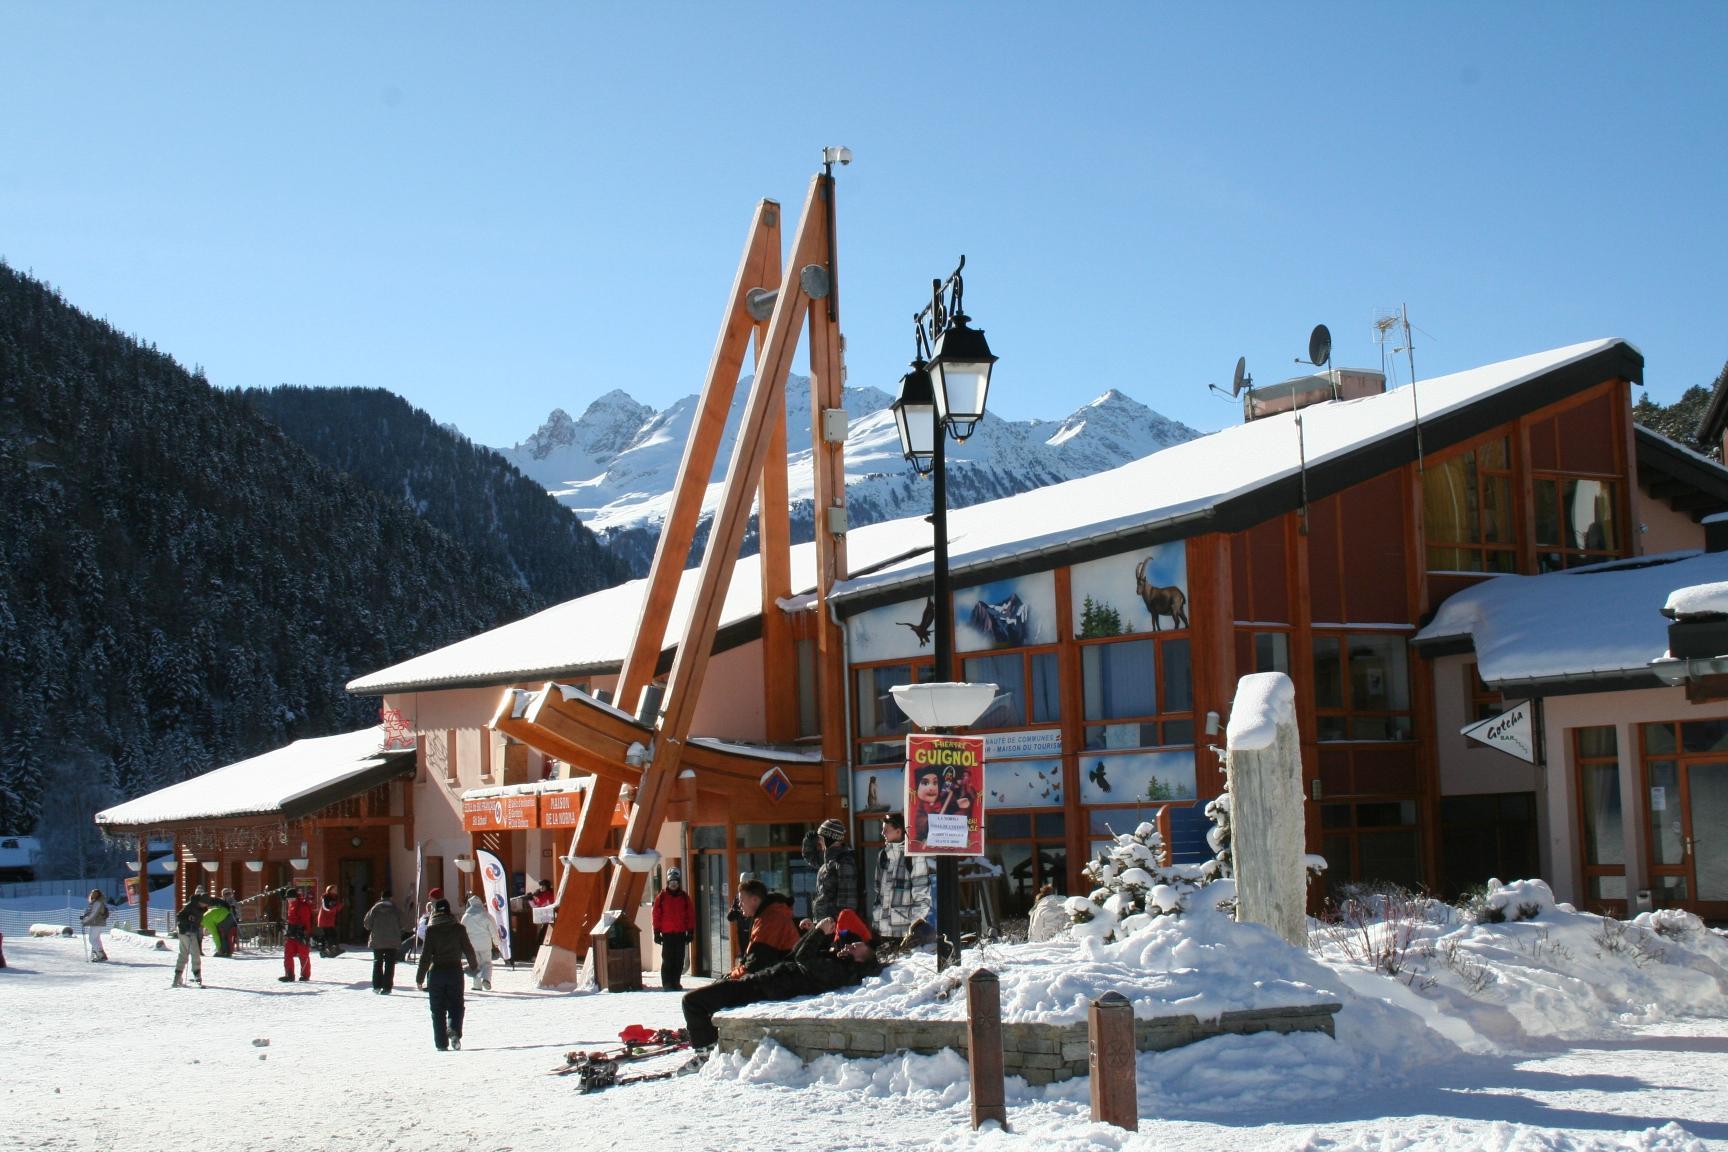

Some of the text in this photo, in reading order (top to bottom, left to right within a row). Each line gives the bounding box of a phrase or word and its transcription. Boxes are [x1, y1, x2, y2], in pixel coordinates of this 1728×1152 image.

[1487, 711, 1523, 739] Gotcha
[996, 744, 1020, 753] MAISON
[1034, 742, 1062, 750] TOURISM
[915, 748, 978, 767] GUIGNOL
